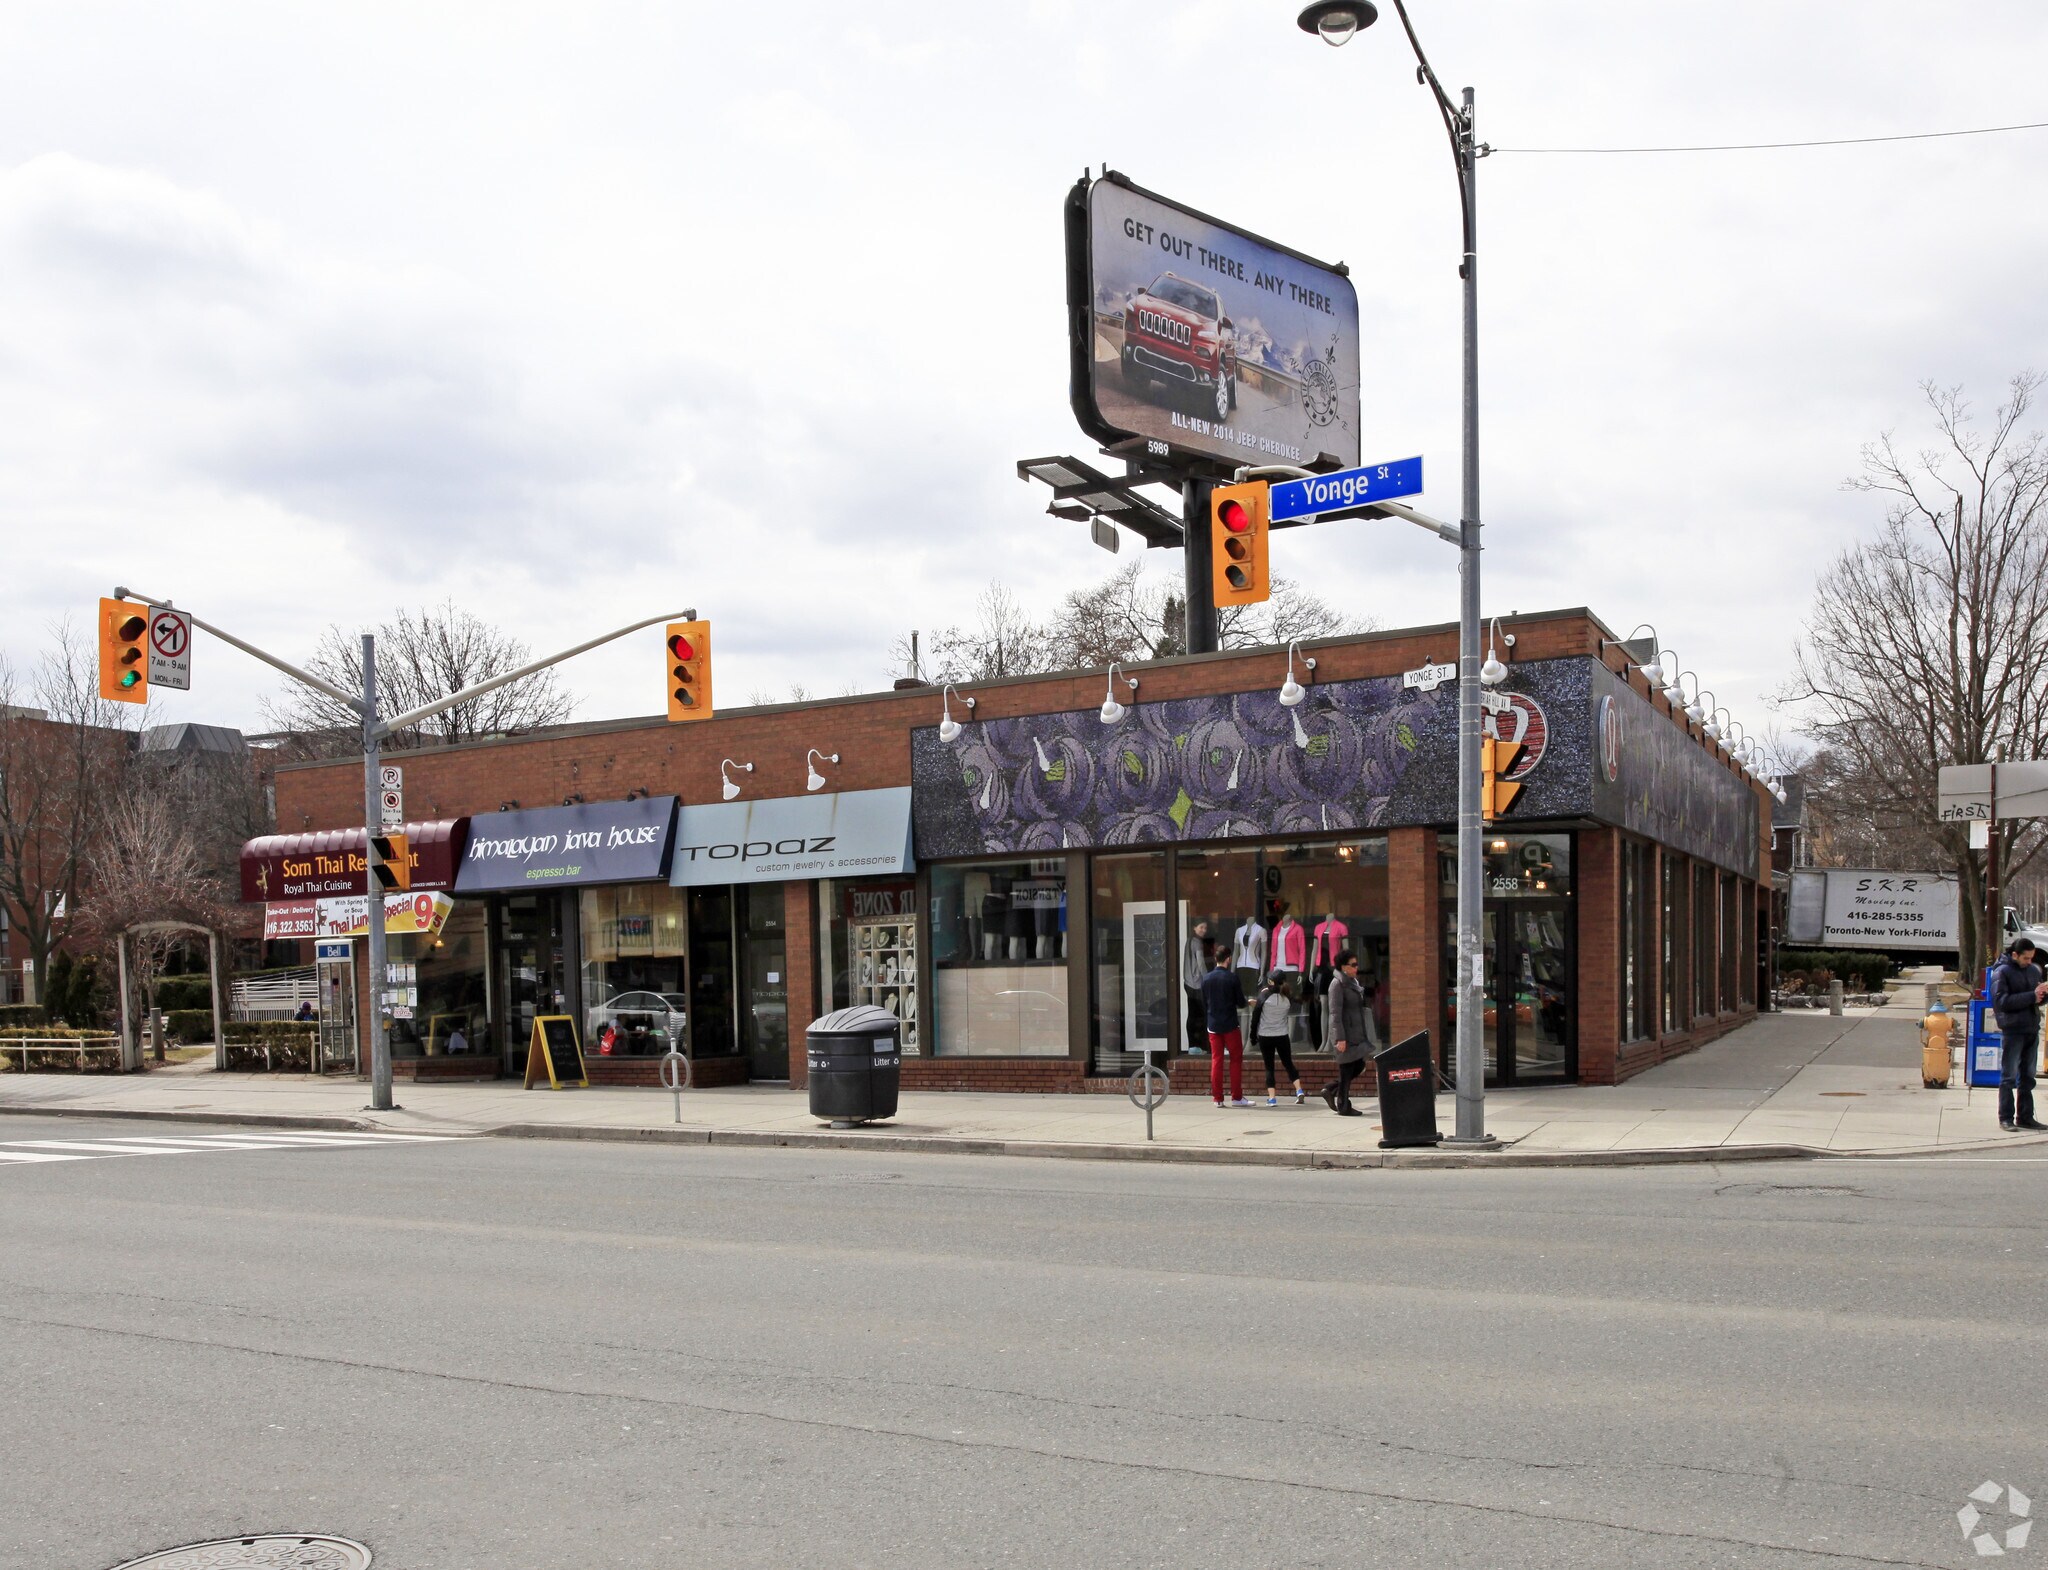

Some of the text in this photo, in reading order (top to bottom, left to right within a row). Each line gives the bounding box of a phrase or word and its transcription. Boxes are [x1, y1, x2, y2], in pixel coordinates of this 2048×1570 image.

[1123, 217, 1335, 316] GET OUT THERE. ANY THERE.
[1171, 411, 1301, 462] ALL-NEW 2014 JEEP CHEROKEE
[1148, 440, 1169, 456] 5989
[1302, 466, 1389, 505] Yonge St
[1409, 667, 1449, 684] YONGE ST.
[561, 829, 602, 855] java
[606, 825, 660, 851] house
[283, 851, 419, 878] Sorn Thai Resnt
[526, 864, 581, 880] espresso bar
[756, 855, 897, 873] custom jewelry & accessories
[284, 880, 352, 895] Royal Thai Cuisine
[1493, 877, 1518, 890] 2558
[1856, 878, 1923, 893] S.K.R.
[1855, 896, 1896, 907] Moving
[292, 906, 314, 914] Delivery
[414, 894, 433, 929] 9
[1847, 912, 1924, 921] 416-285-5355
[328, 914, 369, 935] Thai Lun
[1825, 925, 1946, 938] Toronto-New York-Florida
[327, 946, 341, 957] Bell
[874, 1057, 890, 1067] Litter
